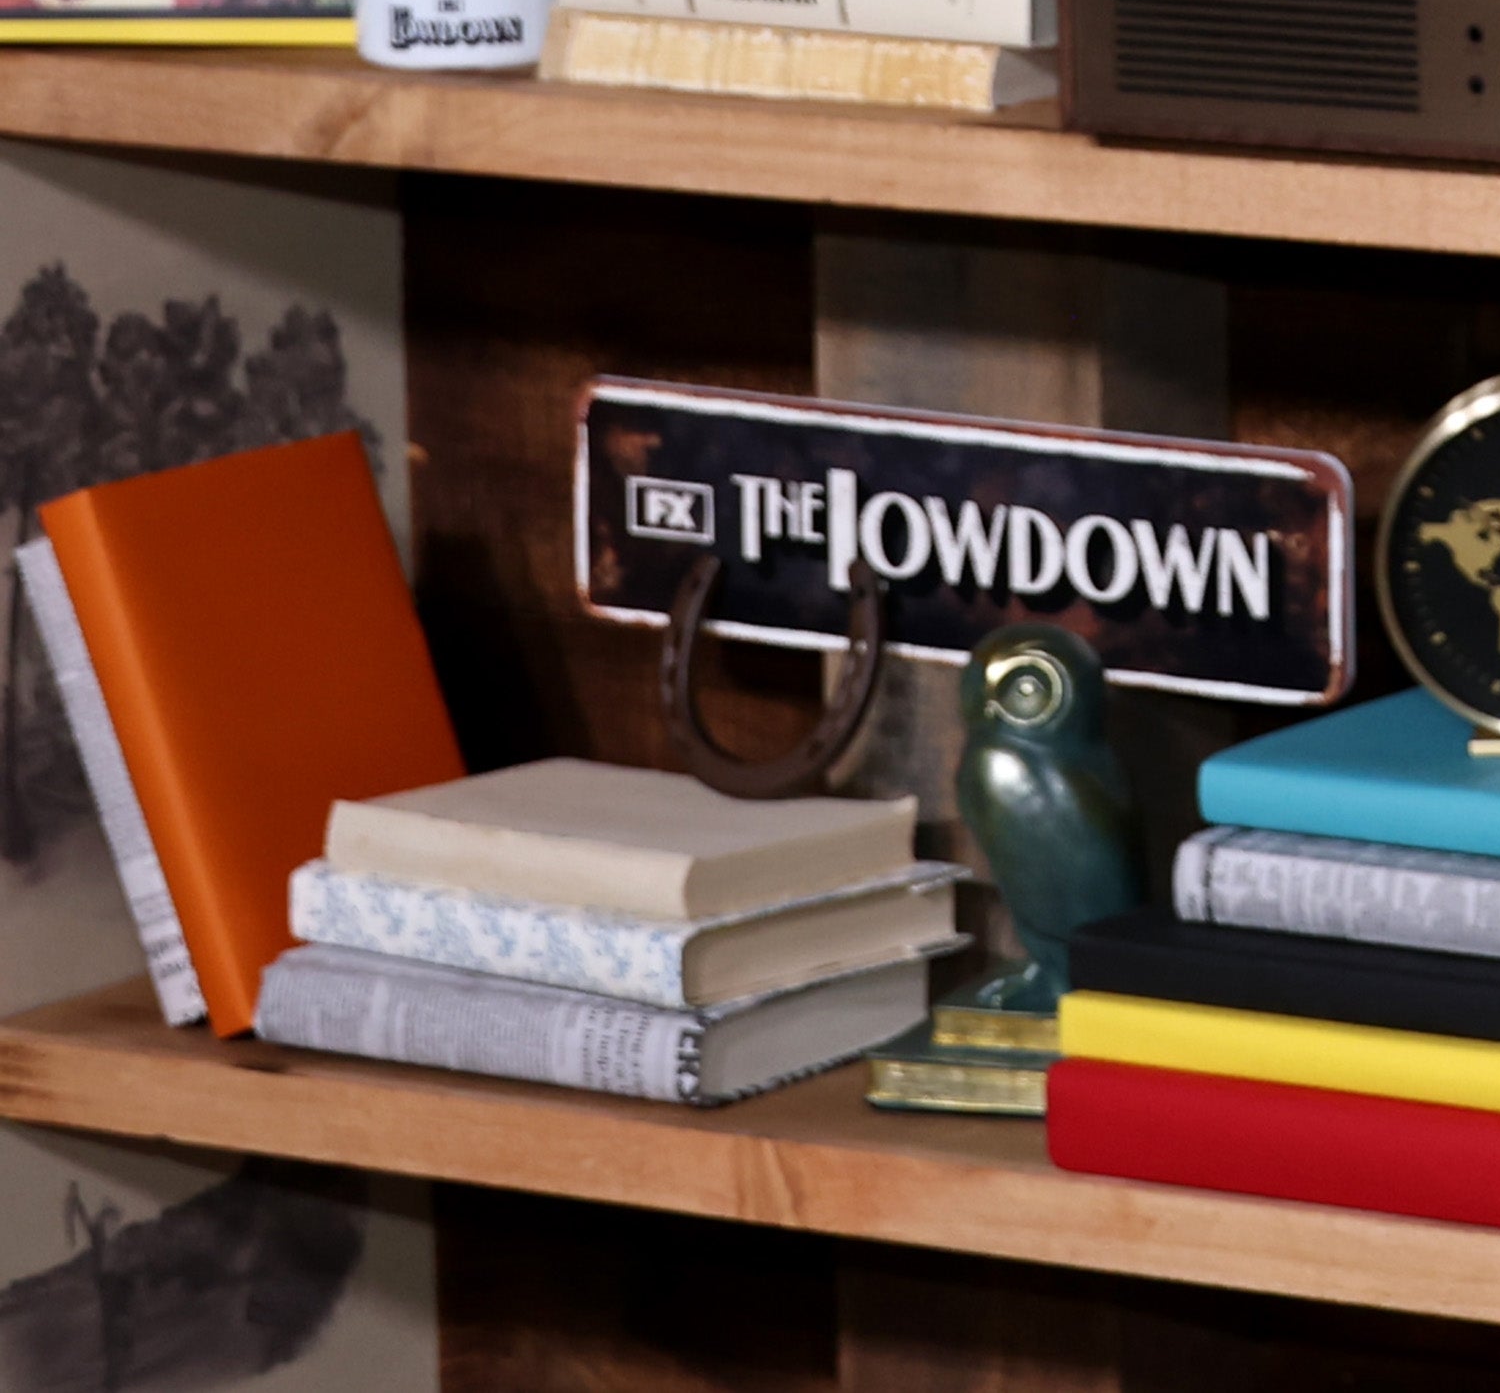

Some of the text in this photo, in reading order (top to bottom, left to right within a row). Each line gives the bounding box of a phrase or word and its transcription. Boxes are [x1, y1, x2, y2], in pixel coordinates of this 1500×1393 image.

[643, 466, 1271, 622] FX THE LOWDOWN
